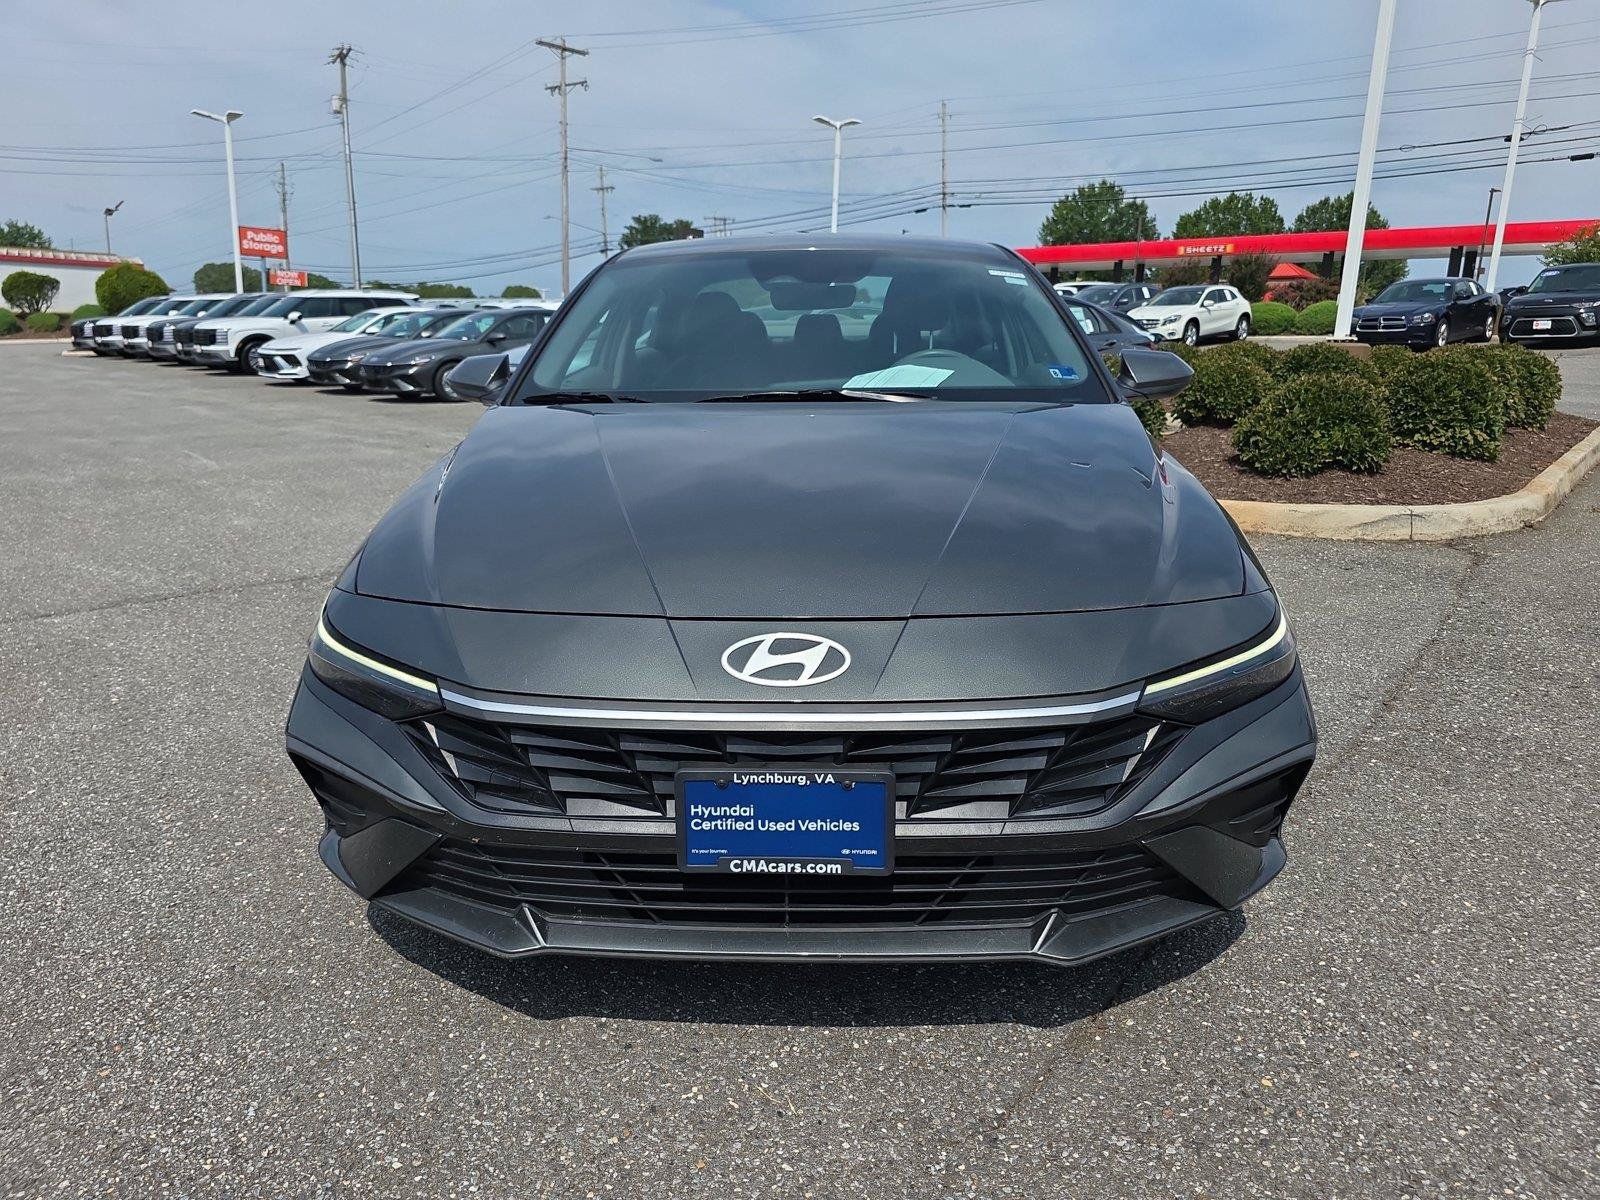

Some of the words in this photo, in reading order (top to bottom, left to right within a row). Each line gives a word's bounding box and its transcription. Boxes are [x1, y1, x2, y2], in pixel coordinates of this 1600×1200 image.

[246, 231, 280, 243] Public
[242, 239, 284, 254] Storage
[1185, 245, 1225, 254] SHEETZ
[733, 773, 810, 785] Lynchburg,
[814, 773, 835, 784] VA
[690, 804, 754, 819] Hyundai
[690, 818, 755, 831] Certified
[757, 819, 795, 831] Used
[798, 819, 860, 831] Vehicles
[729, 859, 842, 874] CMAcars.com
